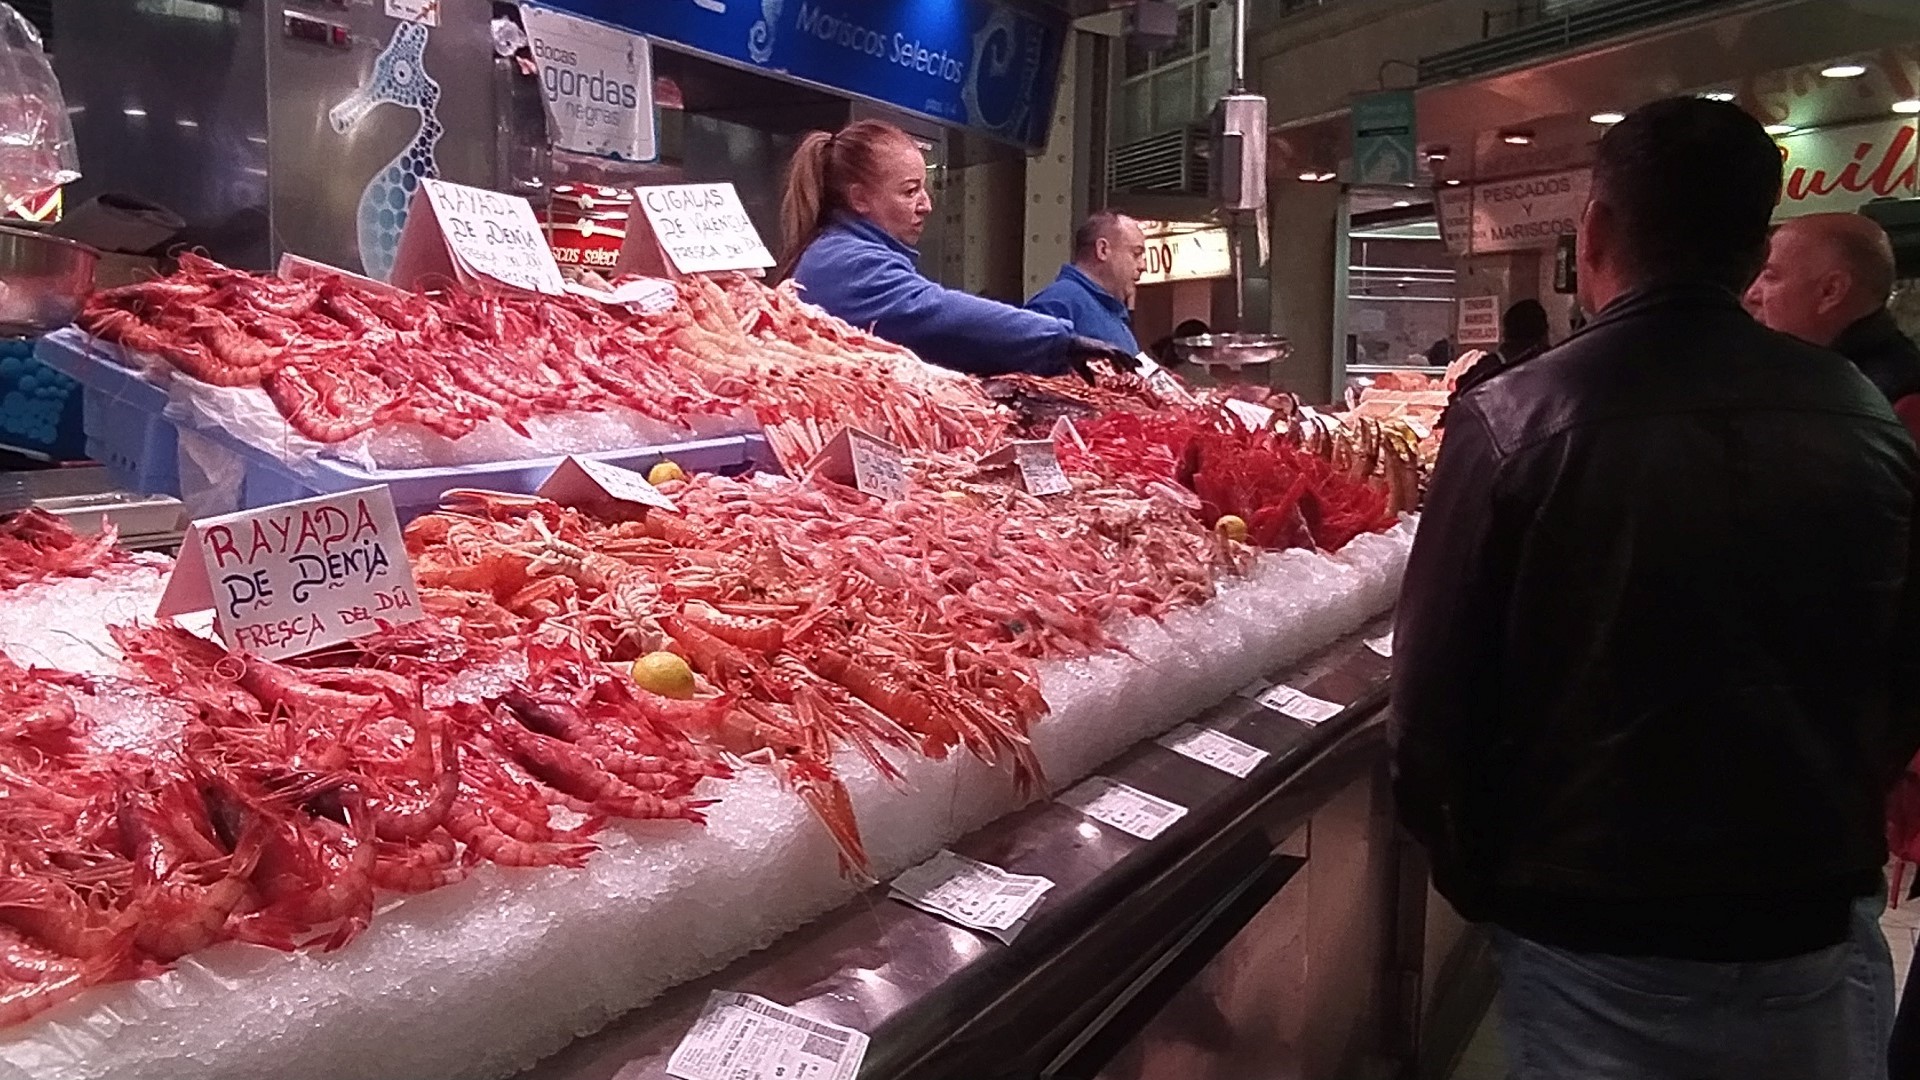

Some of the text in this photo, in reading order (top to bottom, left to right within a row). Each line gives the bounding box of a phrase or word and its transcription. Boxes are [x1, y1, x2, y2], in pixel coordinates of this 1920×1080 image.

[533, 38, 577, 66] Bocas
[796, 2, 887, 58] Mariscos
[889, 32, 963, 83] Selectos
[544, 66, 637, 109] gordas
[566, 103, 620, 127] negras
[431, 181, 520, 219] RAYADA
[646, 189, 724, 213] CIGALAS
[1482, 177, 1572, 202] PESCADOS
[1521, 203, 1533, 217] Y
[449, 217, 477, 243] DE
[658, 217, 686, 240] DE
[1490, 217, 1577, 241] MARISCOS
[583, 247, 621, 266] select
[204, 498, 378, 568] RAYADA
[222, 569, 273, 618] DE
[234, 612, 326, 650] FRESCA
[337, 606, 373, 625] DEL
